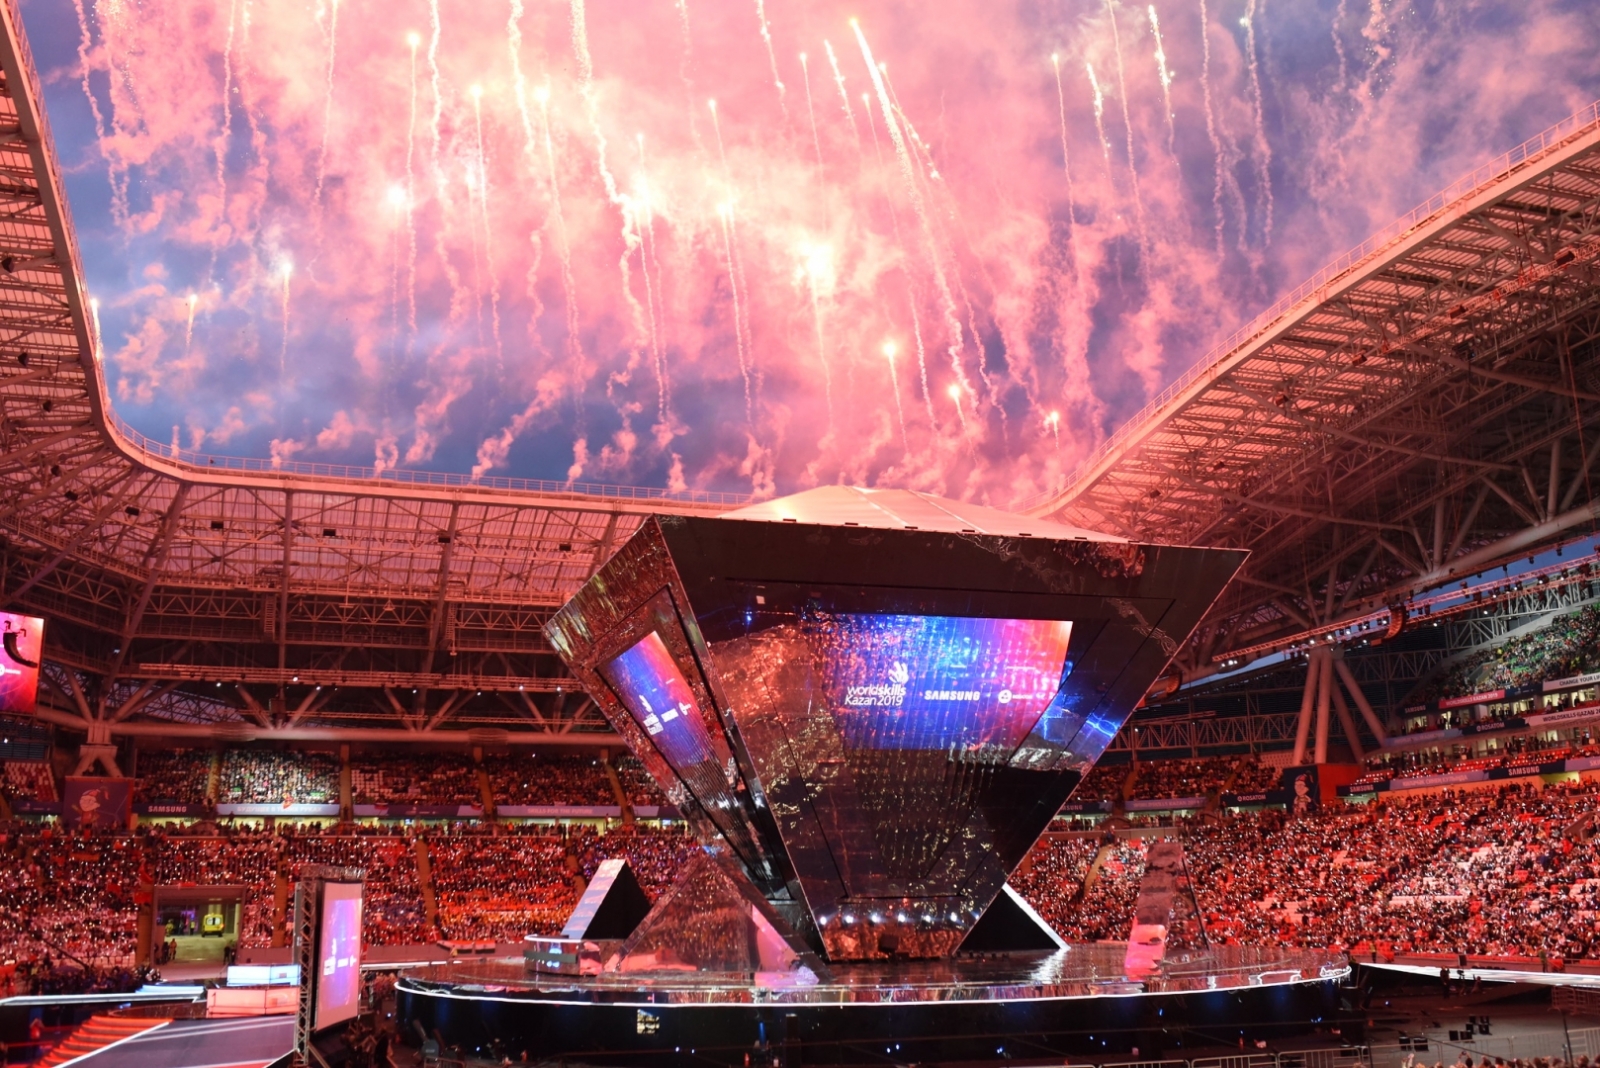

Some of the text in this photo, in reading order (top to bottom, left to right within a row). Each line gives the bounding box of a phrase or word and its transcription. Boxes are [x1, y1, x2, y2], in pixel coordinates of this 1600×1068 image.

[1559, 678, 1579, 686] CHANGE
[847, 683, 907, 697] worldskills
[924, 689, 981, 701] SAMSUNG
[844, 694, 904, 706] Kazan 2019
[1404, 704, 1427, 714] SAMSUNG
[1543, 712, 1576, 722] WORLDSKILLS
[1480, 722, 1505, 731] ROSATOM
[1508, 766, 1540, 776] SAMSUNG
[1350, 784, 1374, 793] SAMSUNG
